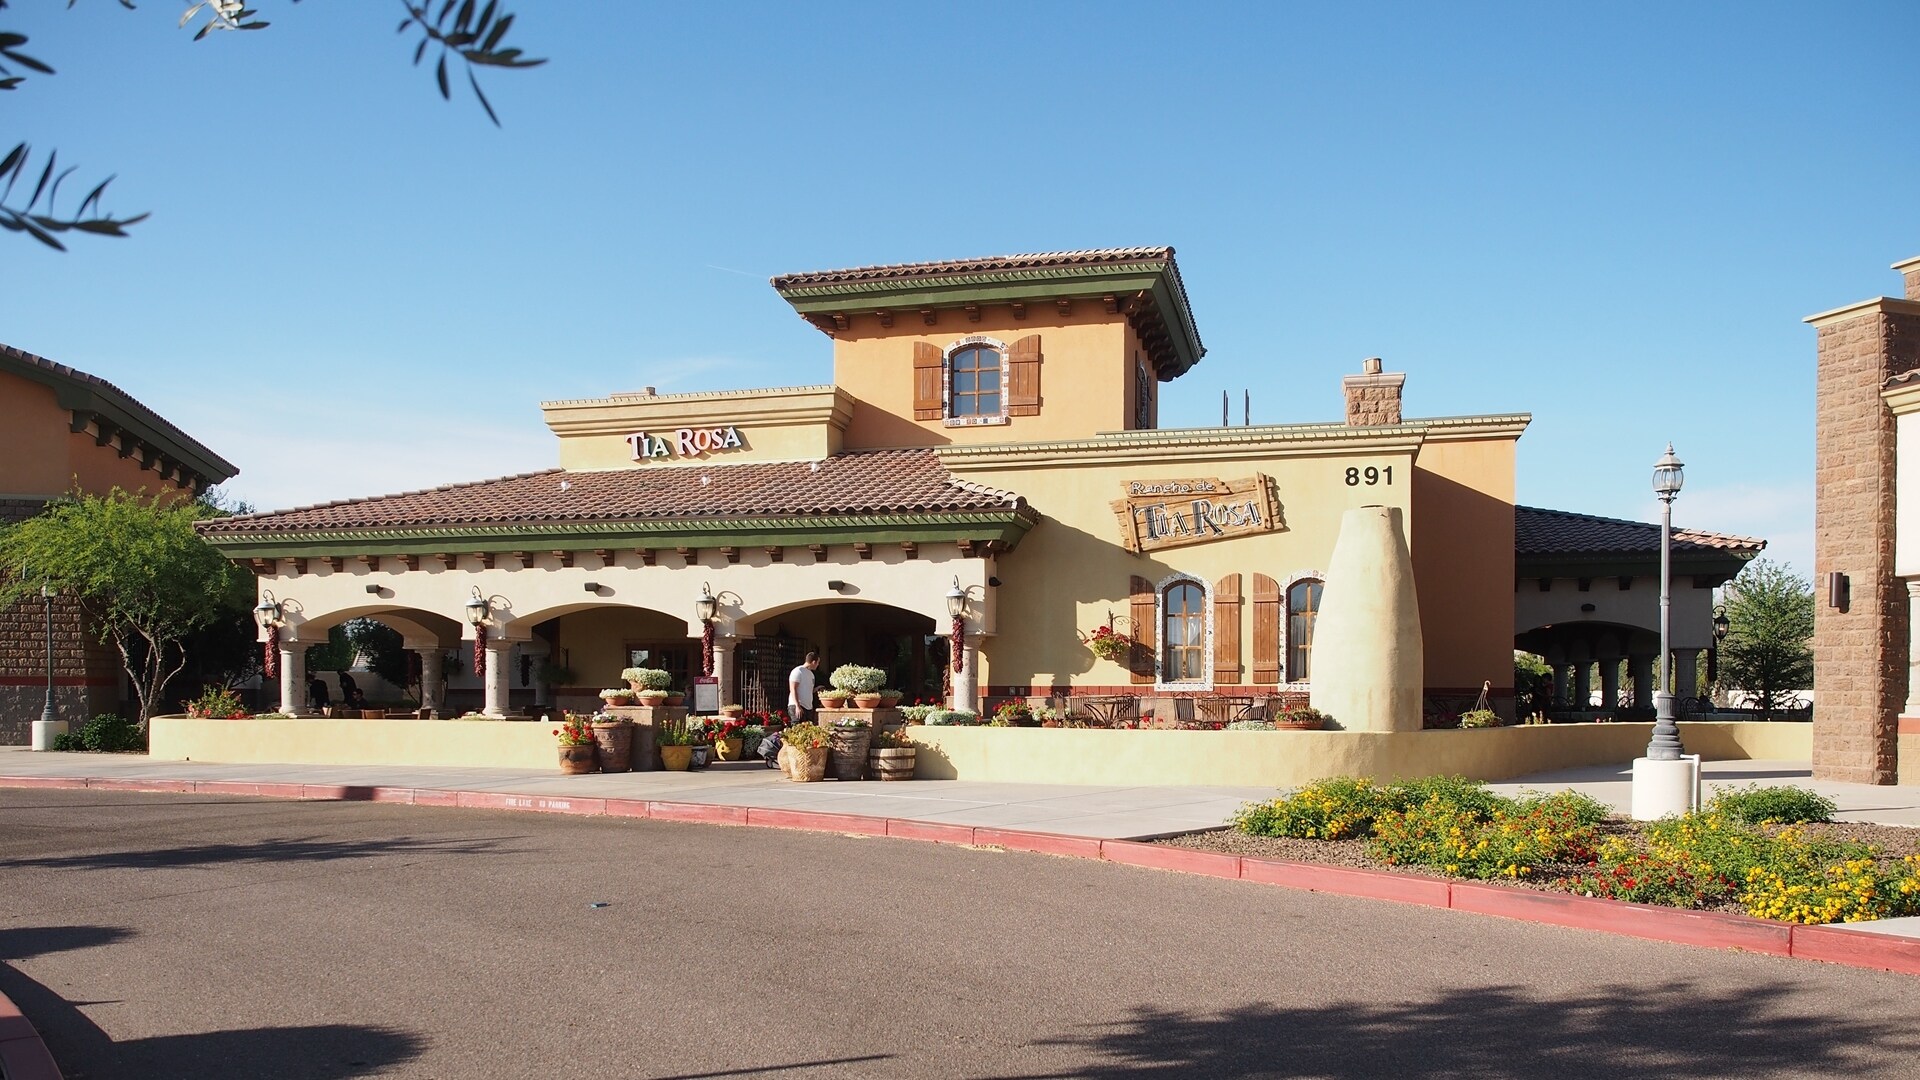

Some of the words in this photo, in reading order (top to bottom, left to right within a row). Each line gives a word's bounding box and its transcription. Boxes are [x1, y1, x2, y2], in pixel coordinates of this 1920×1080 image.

[1345, 465, 1392, 486] 891
[1130, 481, 1191, 494] Rancho
[1195, 481, 1215, 491] de
